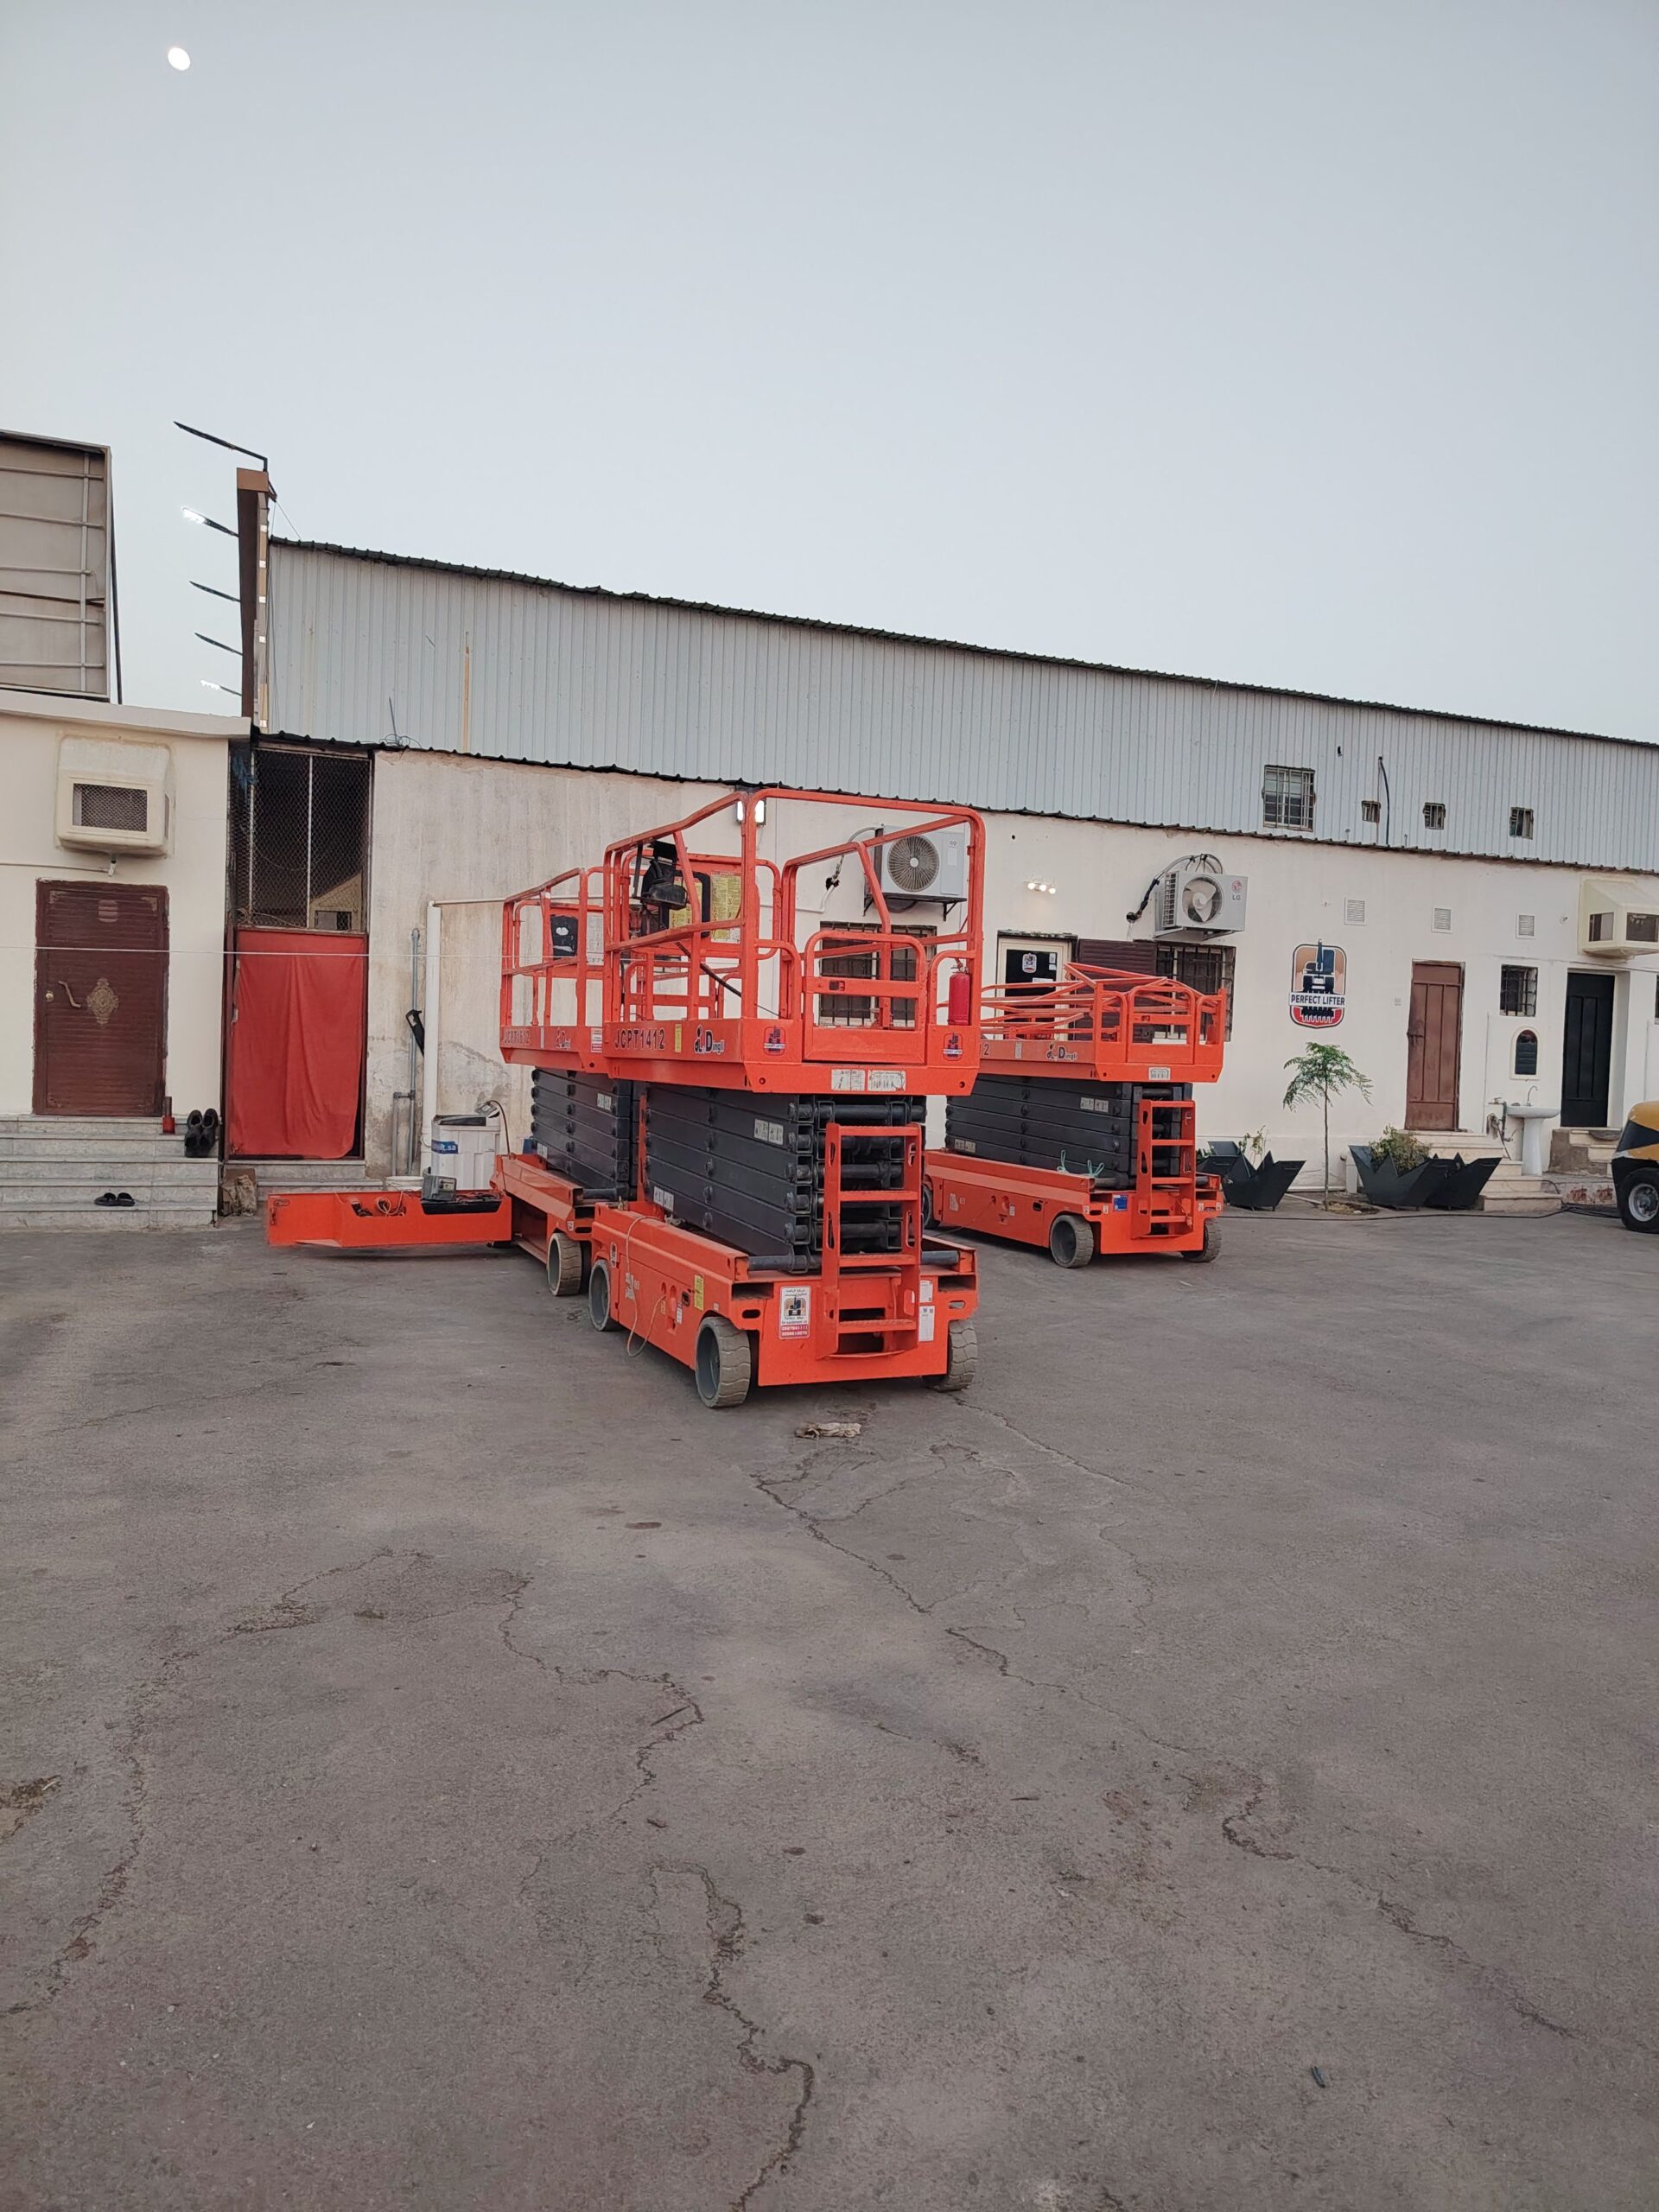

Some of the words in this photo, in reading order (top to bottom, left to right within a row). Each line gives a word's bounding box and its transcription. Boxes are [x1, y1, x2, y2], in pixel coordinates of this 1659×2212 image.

[1291, 994, 1321, 1004] PERFECT
[1322, 995, 1345, 1006] LIFTER
[615, 1027, 664, 1050] JCPT1412
